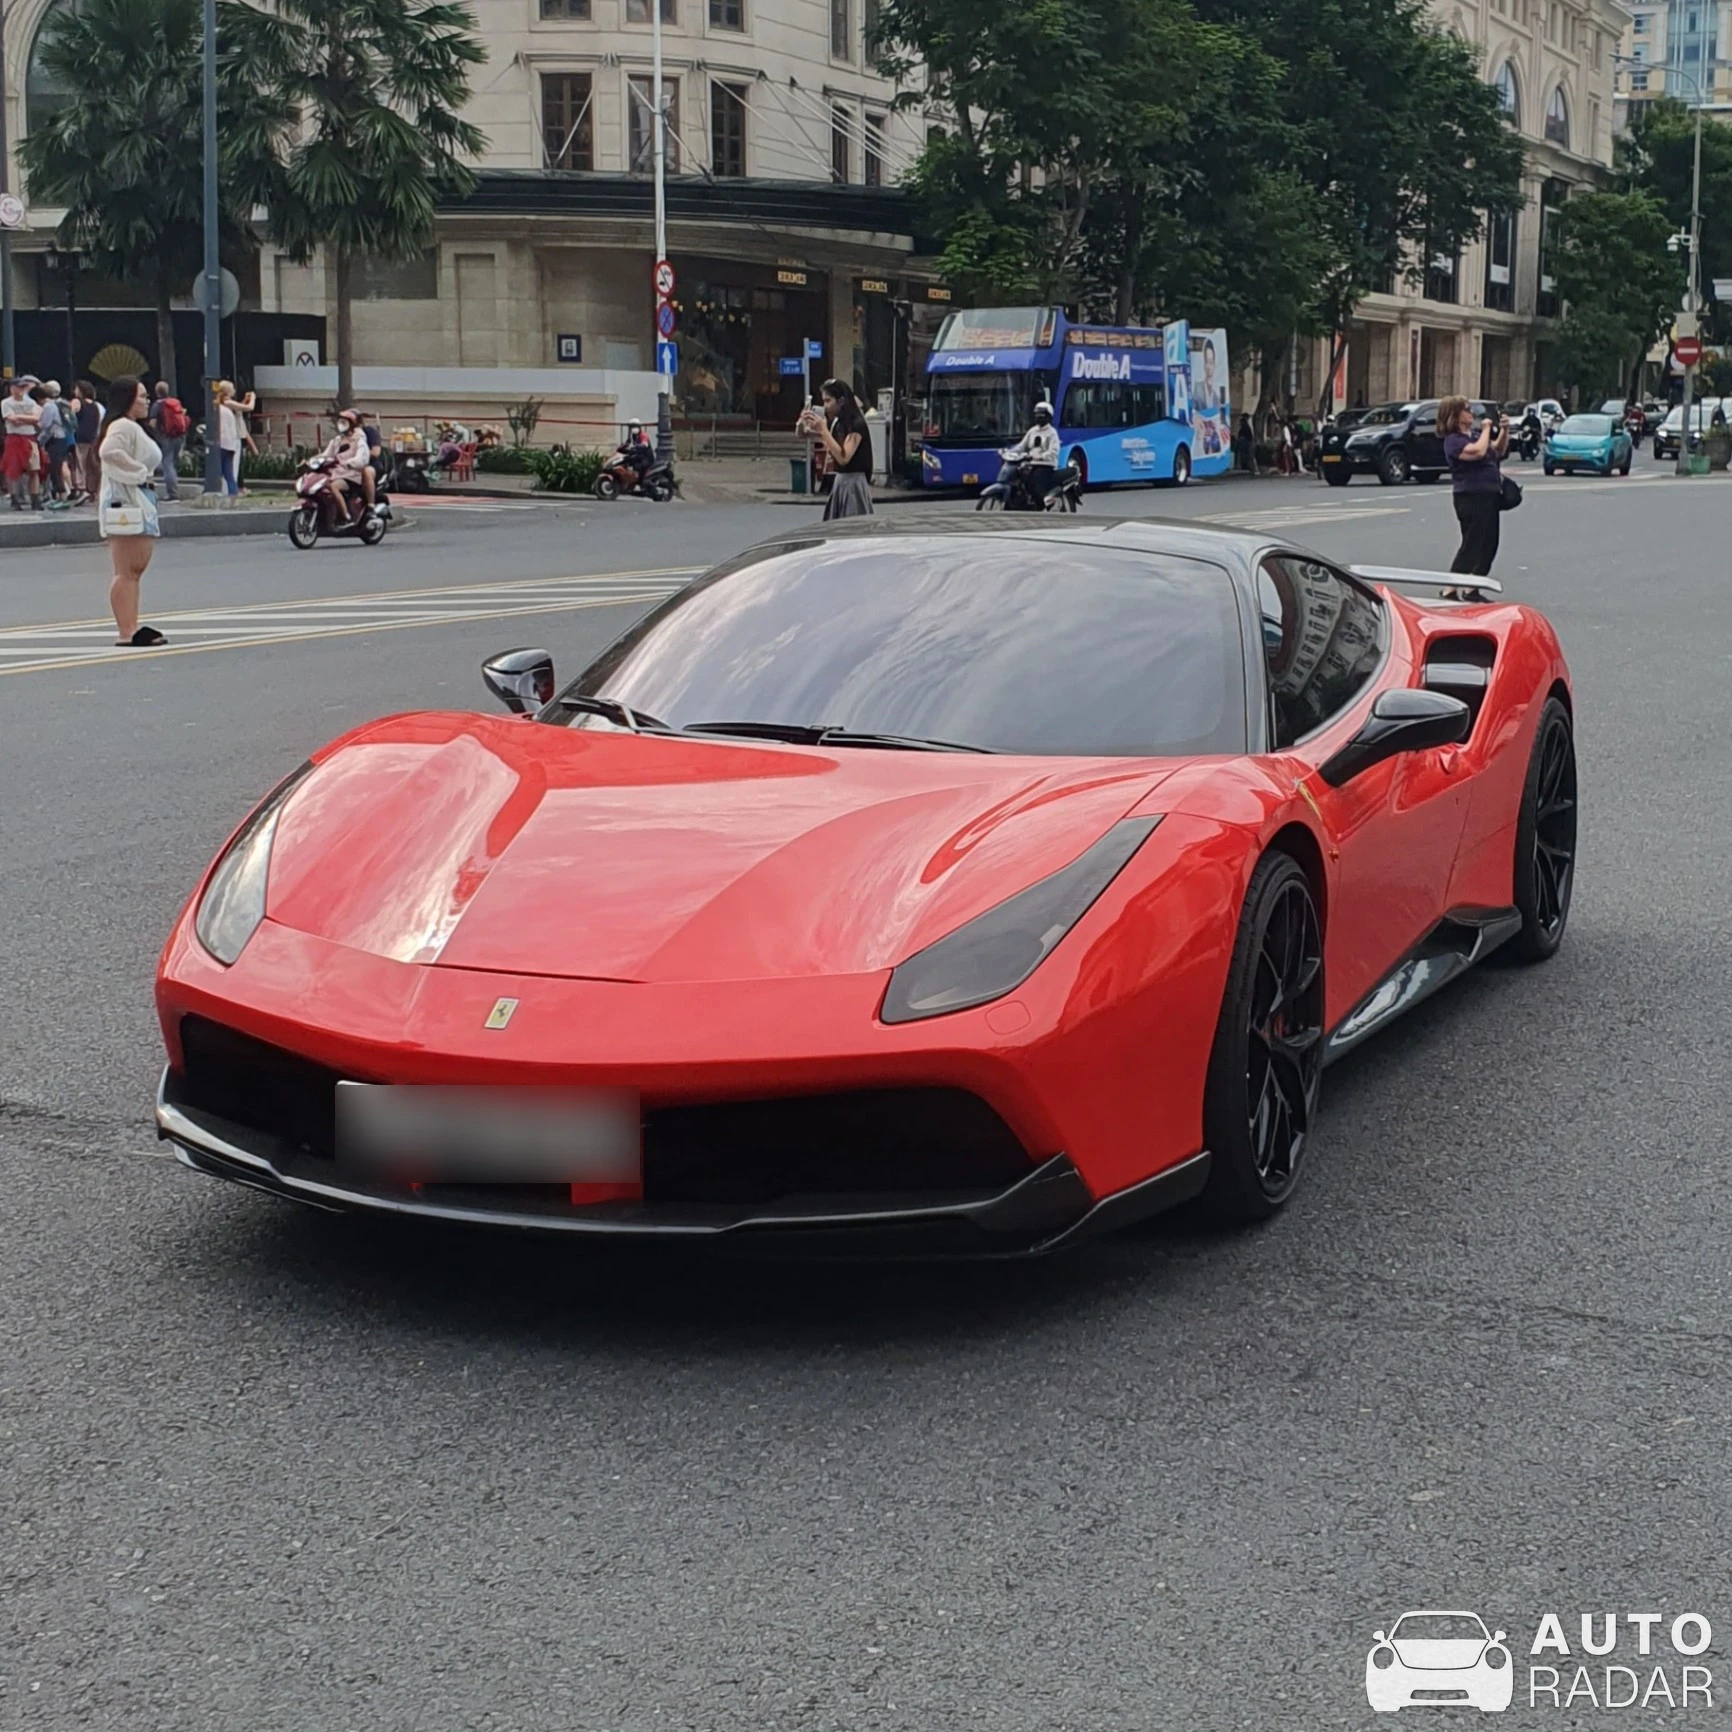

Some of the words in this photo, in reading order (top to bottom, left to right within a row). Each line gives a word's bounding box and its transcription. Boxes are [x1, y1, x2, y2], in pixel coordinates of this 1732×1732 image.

[945, 356, 984, 366] Double
[984, 355, 995, 365] A
[1072, 352, 1119, 379] Double
[1119, 354, 1131, 379] A
